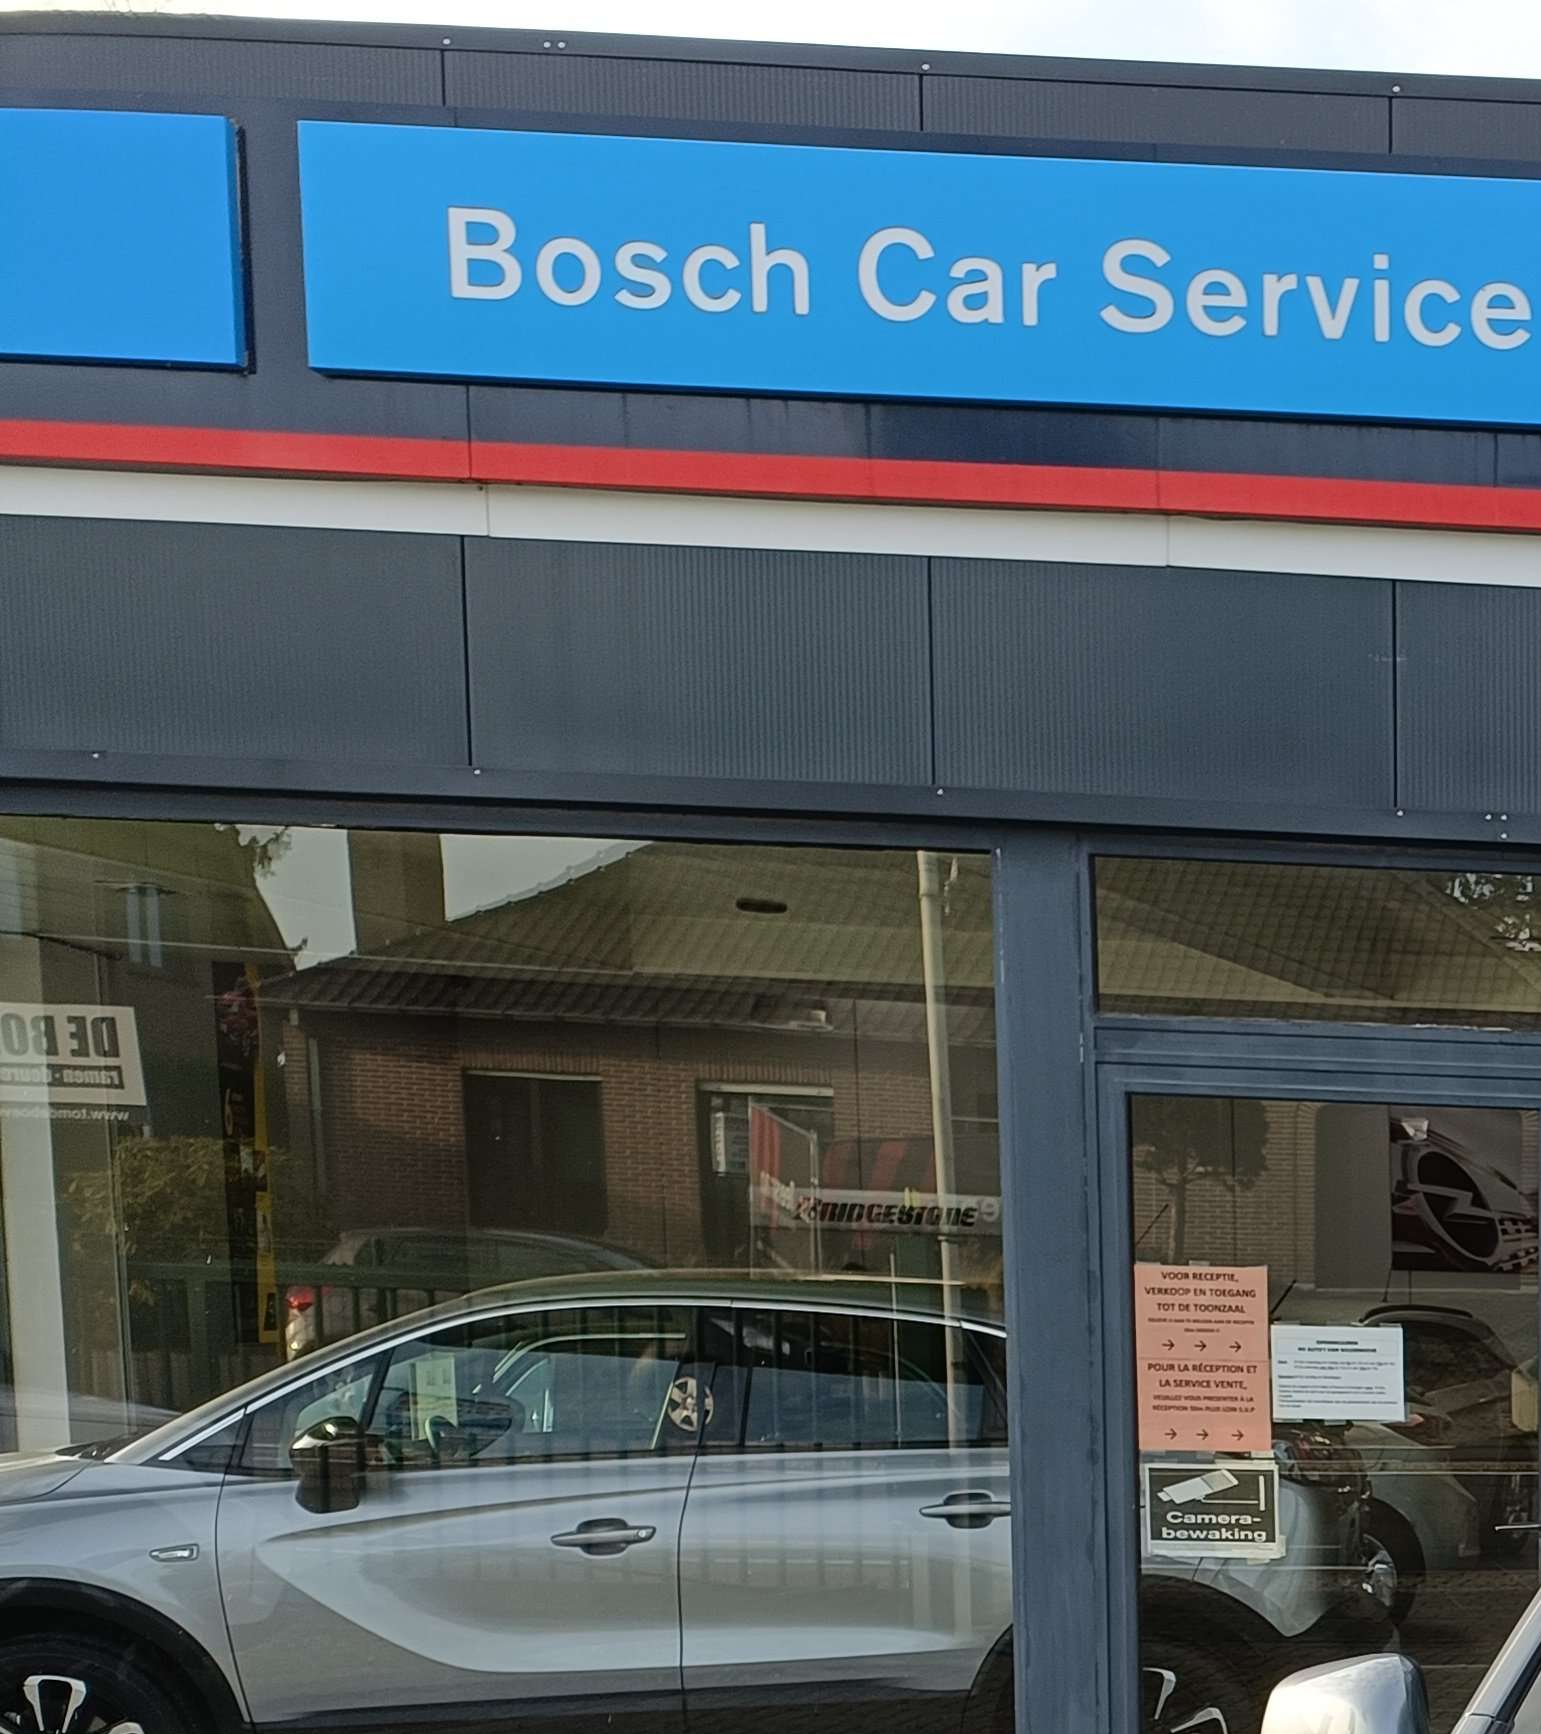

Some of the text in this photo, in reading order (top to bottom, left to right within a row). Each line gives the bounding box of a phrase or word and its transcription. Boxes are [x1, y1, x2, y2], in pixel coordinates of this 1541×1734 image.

[446, 206, 1532, 351] Bosch Car Service
[1161, 1271, 1190, 1280] VOOR
[1144, 1286, 1256, 1298] VERKOOP EN TOEGANG
[1156, 1302, 1246, 1313] TOT DE TOONZAAL
[1147, 1362, 1257, 1374] POUR LA RÉCEPTION ET
[1159, 1379, 1171, 1388] LA
[1173, 1379, 1212, 1389] SERVICE
[1166, 1511, 1262, 1525] Camera-
[1161, 1527, 1267, 1543] bewaking
